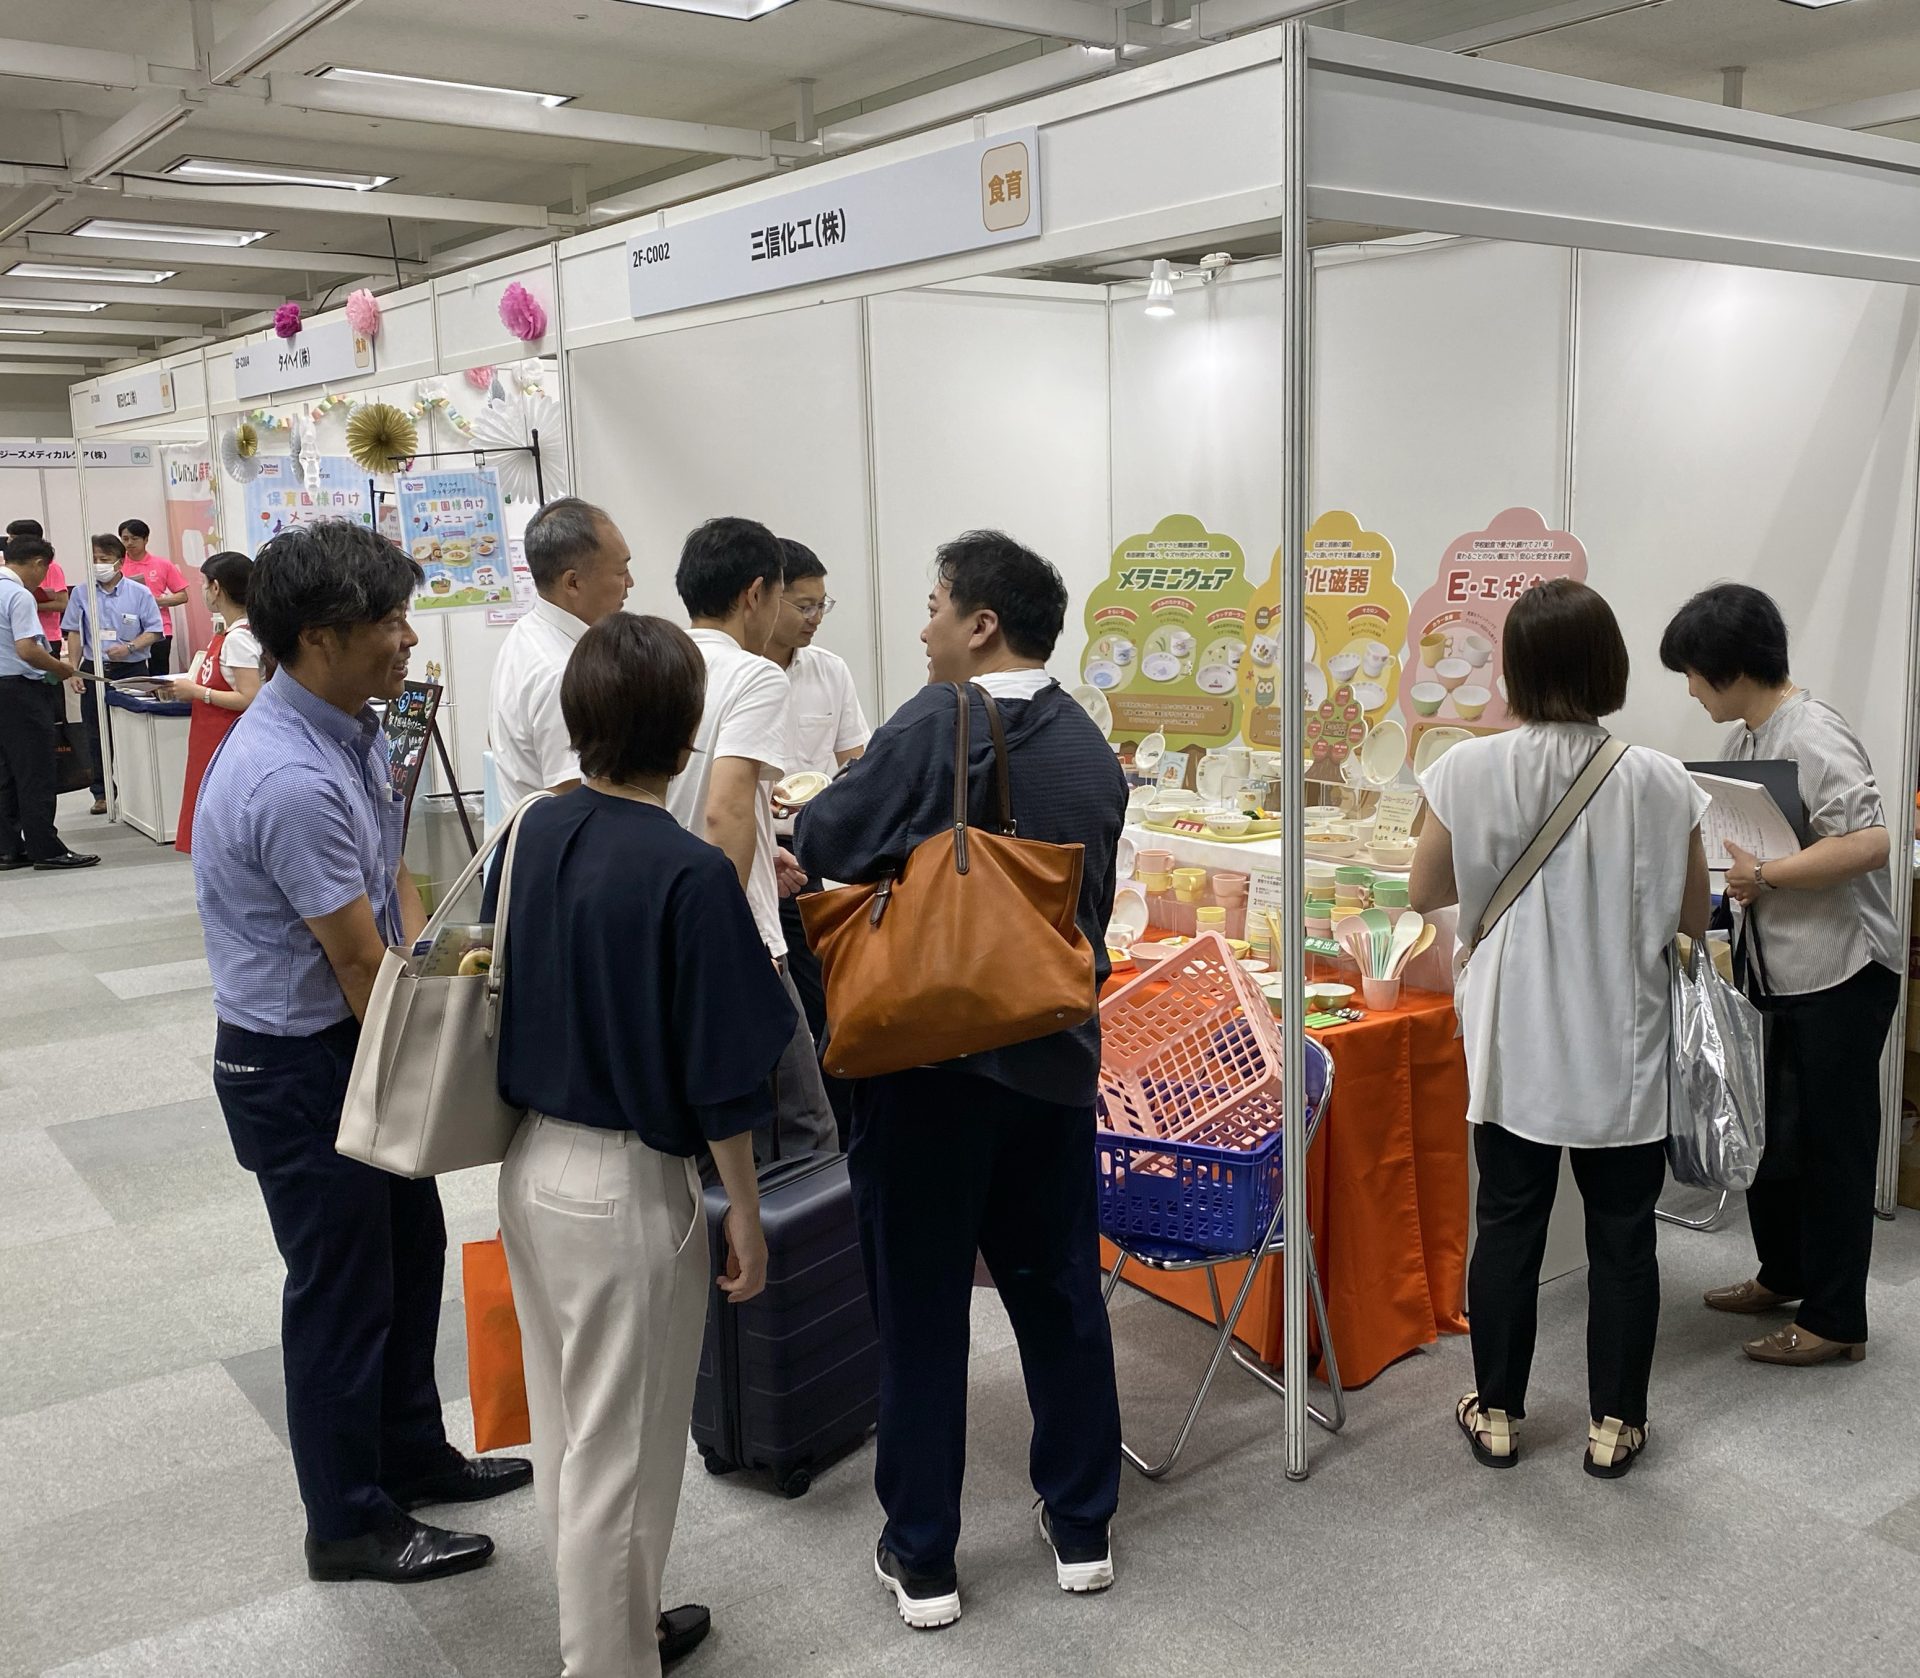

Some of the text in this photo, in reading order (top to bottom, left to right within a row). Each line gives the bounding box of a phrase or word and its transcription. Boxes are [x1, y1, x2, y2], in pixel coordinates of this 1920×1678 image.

[988, 169, 1023, 206] 食育
[750, 207, 846, 262] 三信化工(株)
[632, 242, 670, 268] 2F-C002
[277, 347, 311, 372] タイヘイ(株)
[416, 498, 485, 513] 保育園様向け
[433, 514, 474, 525] メニュー
[1117, 567, 1235, 590] メラミンウェア
[1304, 567, 1370, 594] 化磁器
